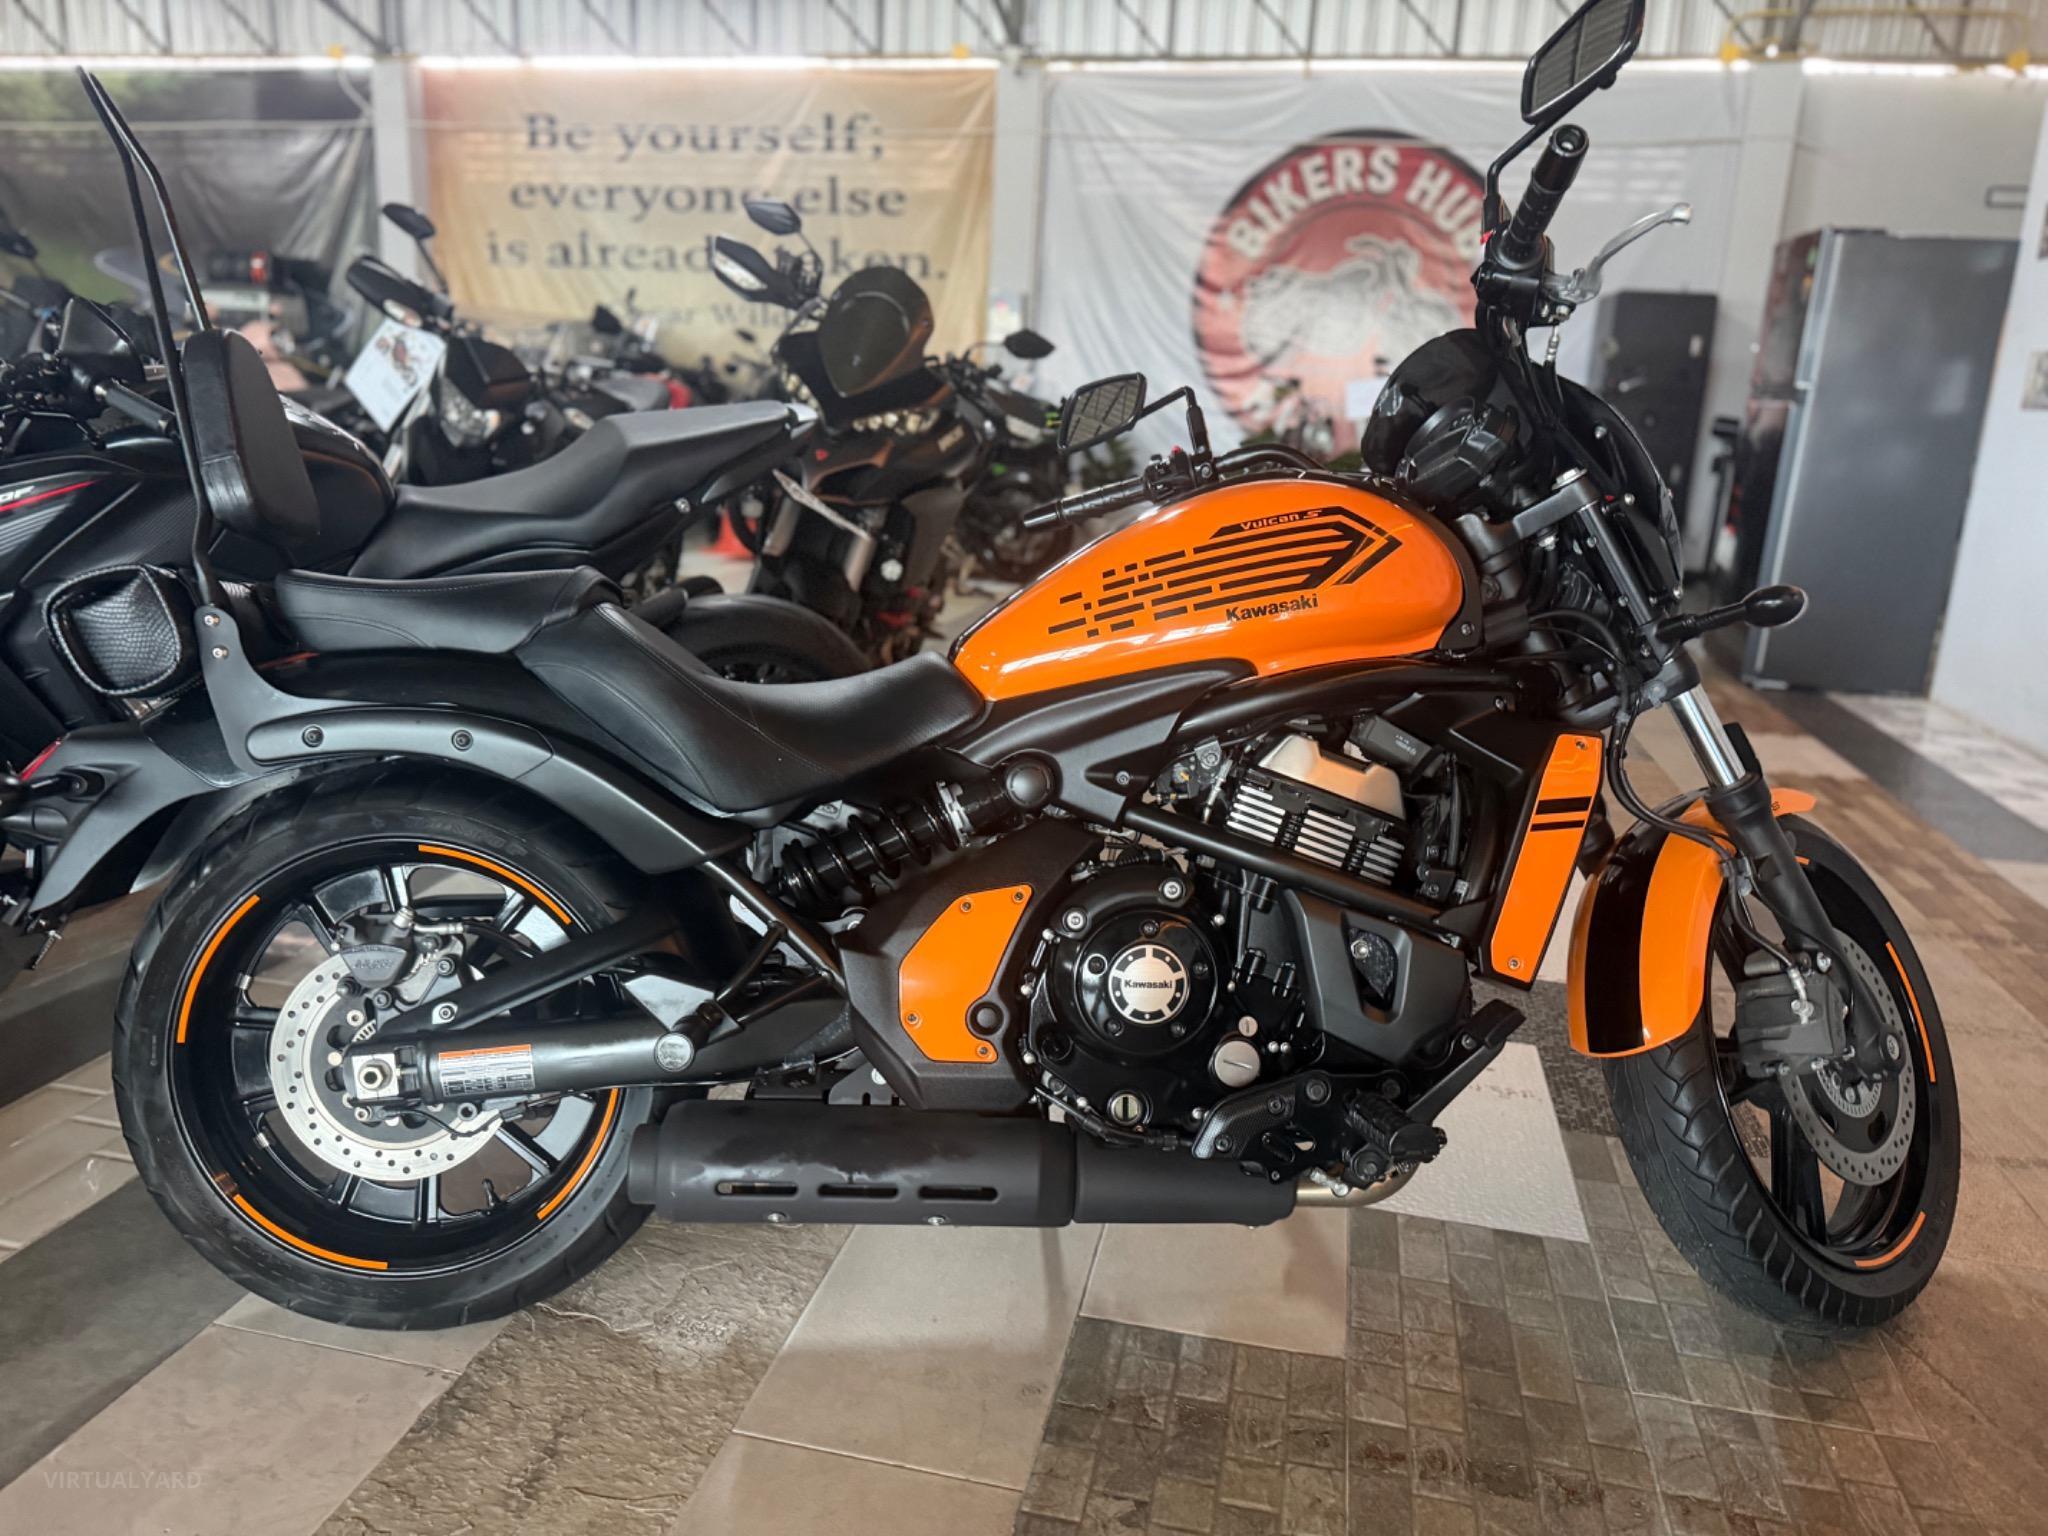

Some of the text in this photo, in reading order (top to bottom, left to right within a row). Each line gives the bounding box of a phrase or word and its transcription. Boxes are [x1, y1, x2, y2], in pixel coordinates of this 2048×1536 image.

[525, 113, 883, 162] Be yourself;
[794, 176, 907, 216] else
[1226, 147, 1402, 261] BIKERS
[489, 230, 528, 264] is
[546, 229, 716, 272] alread
[1240, 509, 1323, 531] Vulcan S
[1226, 593, 1319, 621] Kawasaki
[1124, 979, 1173, 989] Kawasaki
